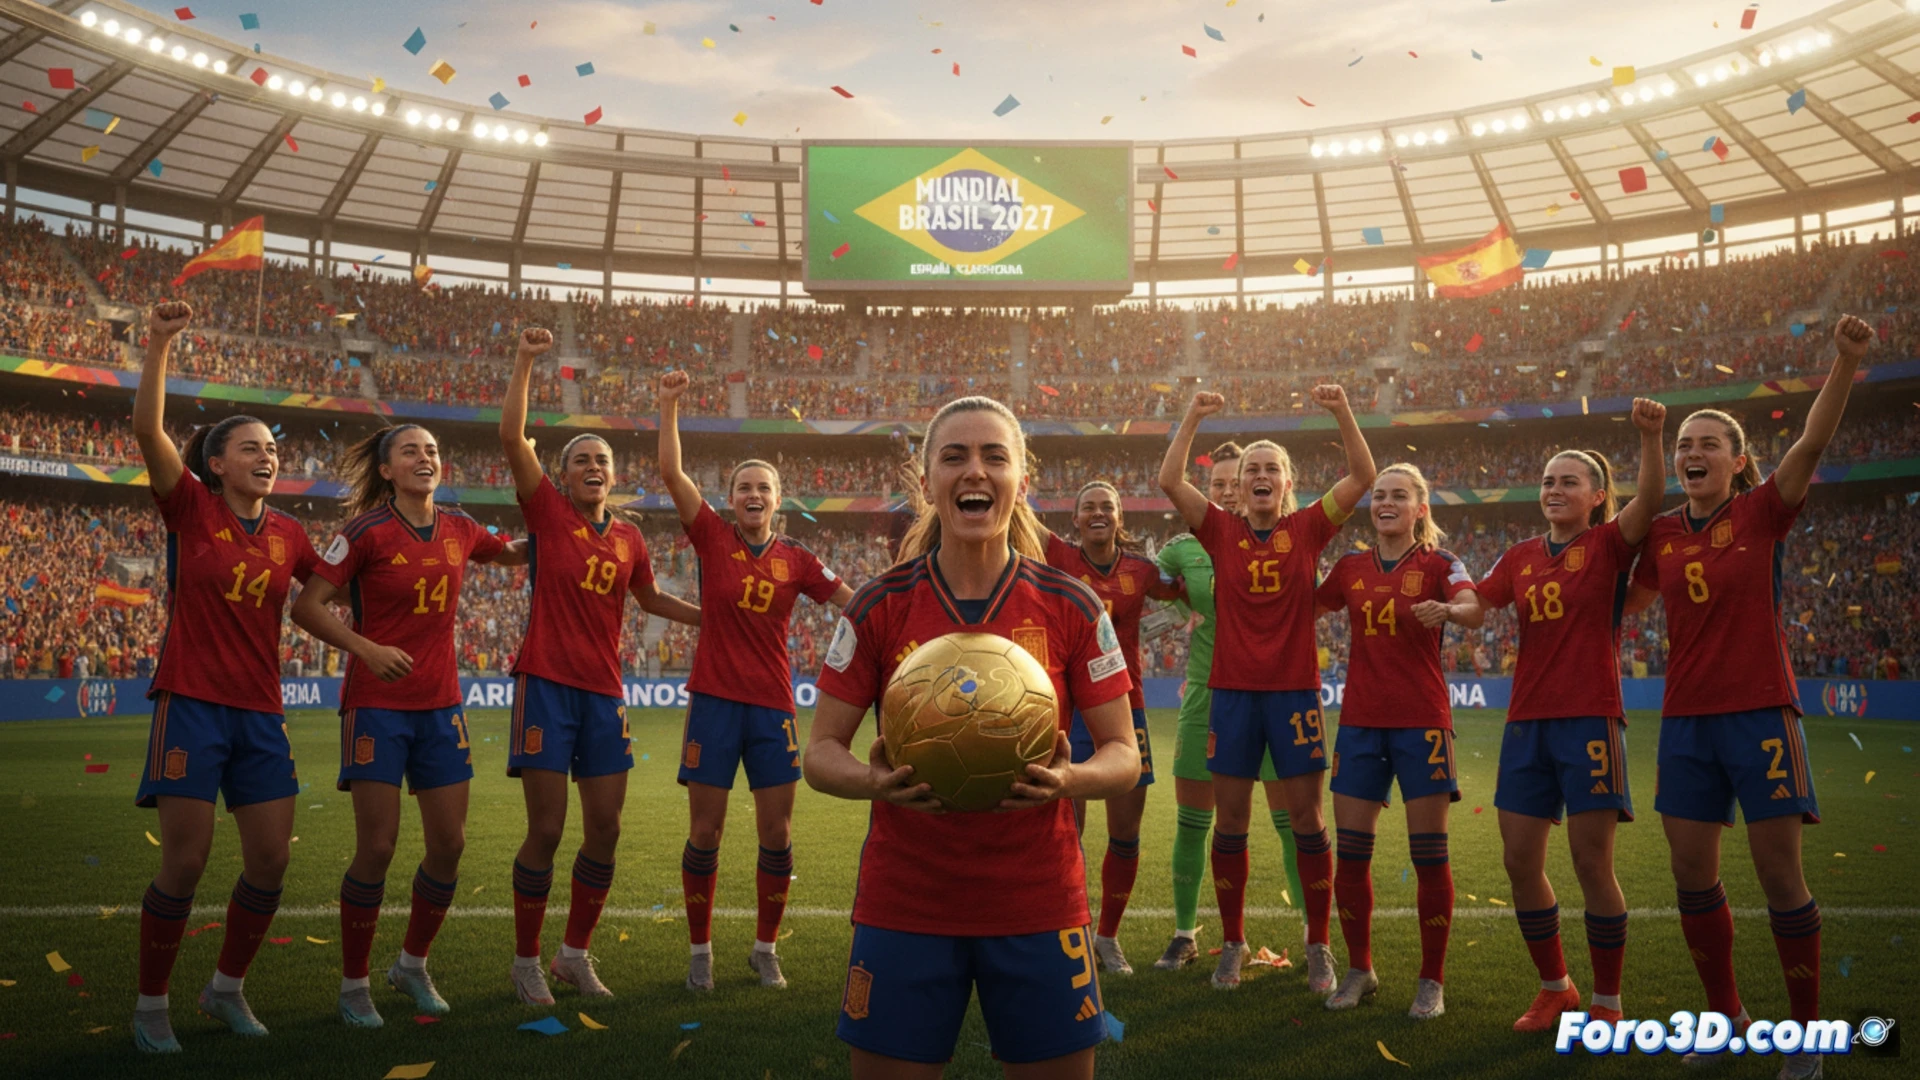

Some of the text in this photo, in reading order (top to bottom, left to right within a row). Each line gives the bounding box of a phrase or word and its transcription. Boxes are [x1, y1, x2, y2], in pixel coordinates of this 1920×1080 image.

[915, 177, 1024, 202] MUNDIAL
[900, 205, 1054, 231] BRASIL 2027
[225, 561, 271, 608] 14
[413, 574, 449, 614] 14
[580, 555, 617, 595] 19
[737, 575, 775, 613] 19
[1248, 559, 1281, 593] 15
[1684, 561, 1709, 604] 8
[1361, 598, 1396, 636] 14
[1525, 581, 1564, 623] 18
[1289, 709, 1323, 746] 19
[1424, 729, 1446, 765] 2
[1586, 740, 1609, 777] 9
[1760, 738, 1788, 780] 2
[1058, 927, 1092, 989] 9
